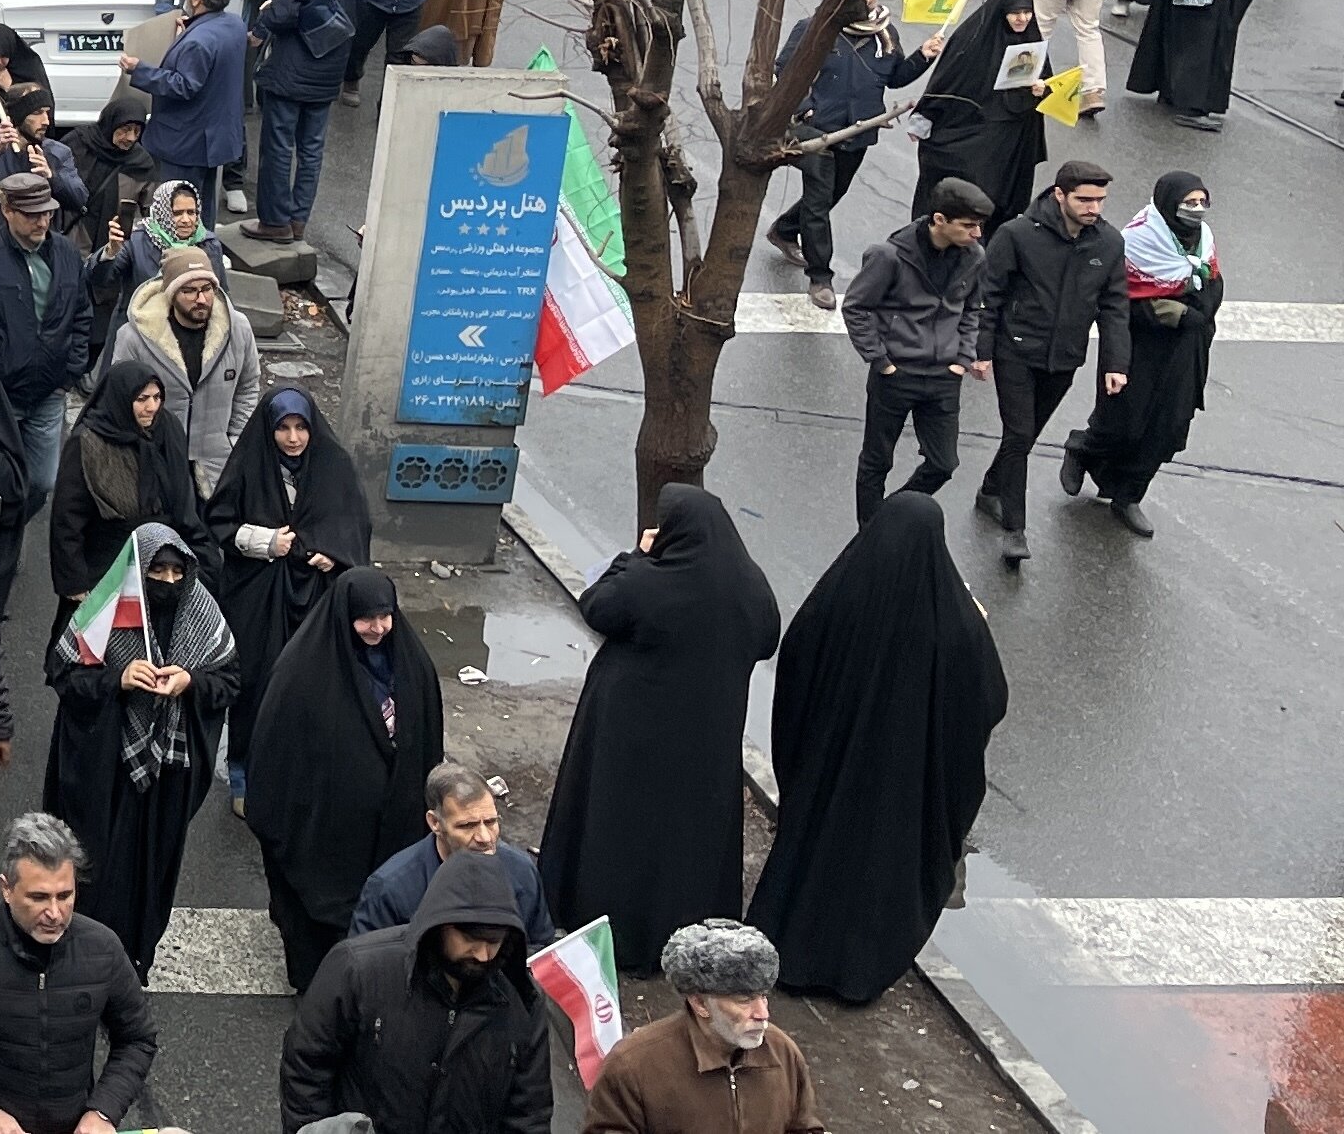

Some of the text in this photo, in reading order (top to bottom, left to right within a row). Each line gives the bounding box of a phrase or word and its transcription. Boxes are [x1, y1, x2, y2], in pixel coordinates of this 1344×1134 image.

[439, 192, 547, 219] هتل پردیس
[486, 242, 514, 256] فرهنگی
[515, 245, 545, 257] مجموعه
[517, 286, 537, 296] TRX
[424, 352, 444, 364] حسن
